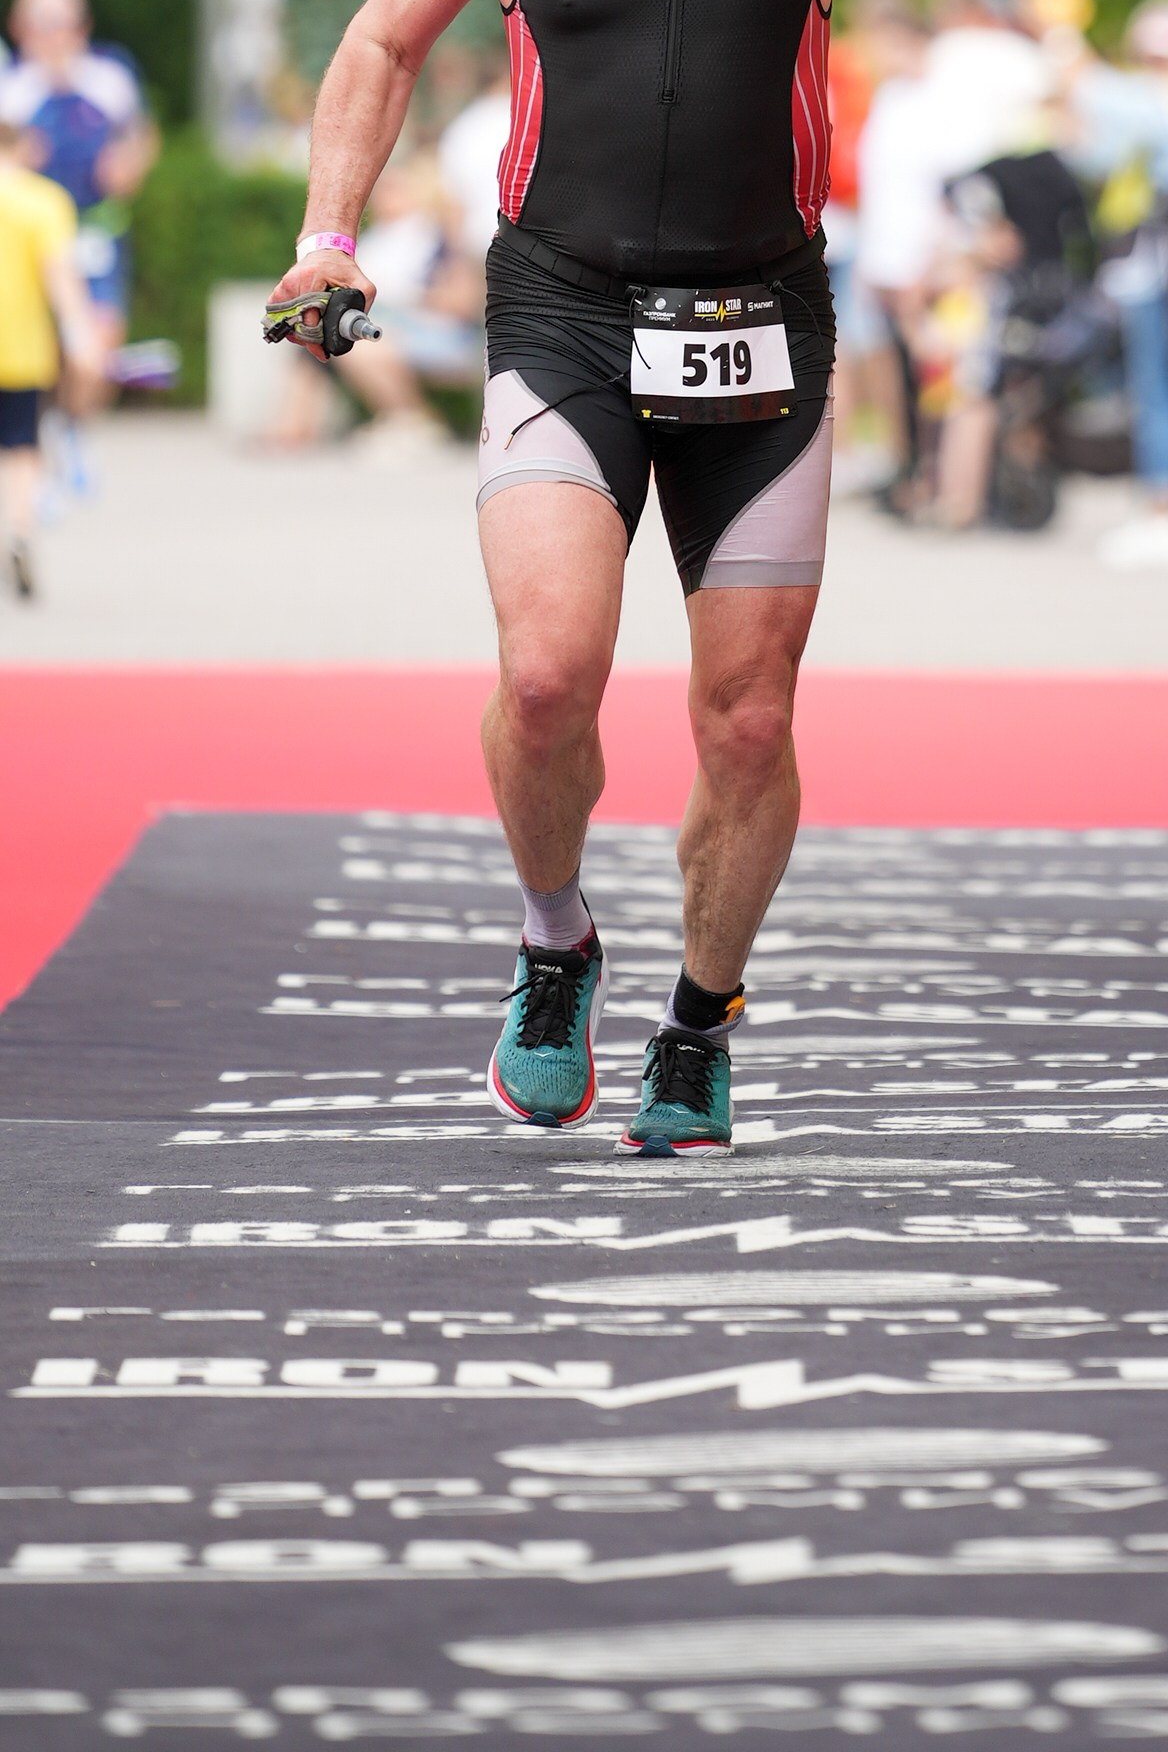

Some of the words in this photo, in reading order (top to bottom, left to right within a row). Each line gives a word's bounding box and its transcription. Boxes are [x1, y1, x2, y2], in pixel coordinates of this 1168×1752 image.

[694, 300, 718, 313] IRON
[725, 298, 741, 311] STAR
[682, 340, 753, 387] 519
[110, 1215, 625, 1241] IRON
[31, 1357, 613, 1387] IRON
[12, 1539, 593, 1572] RON
